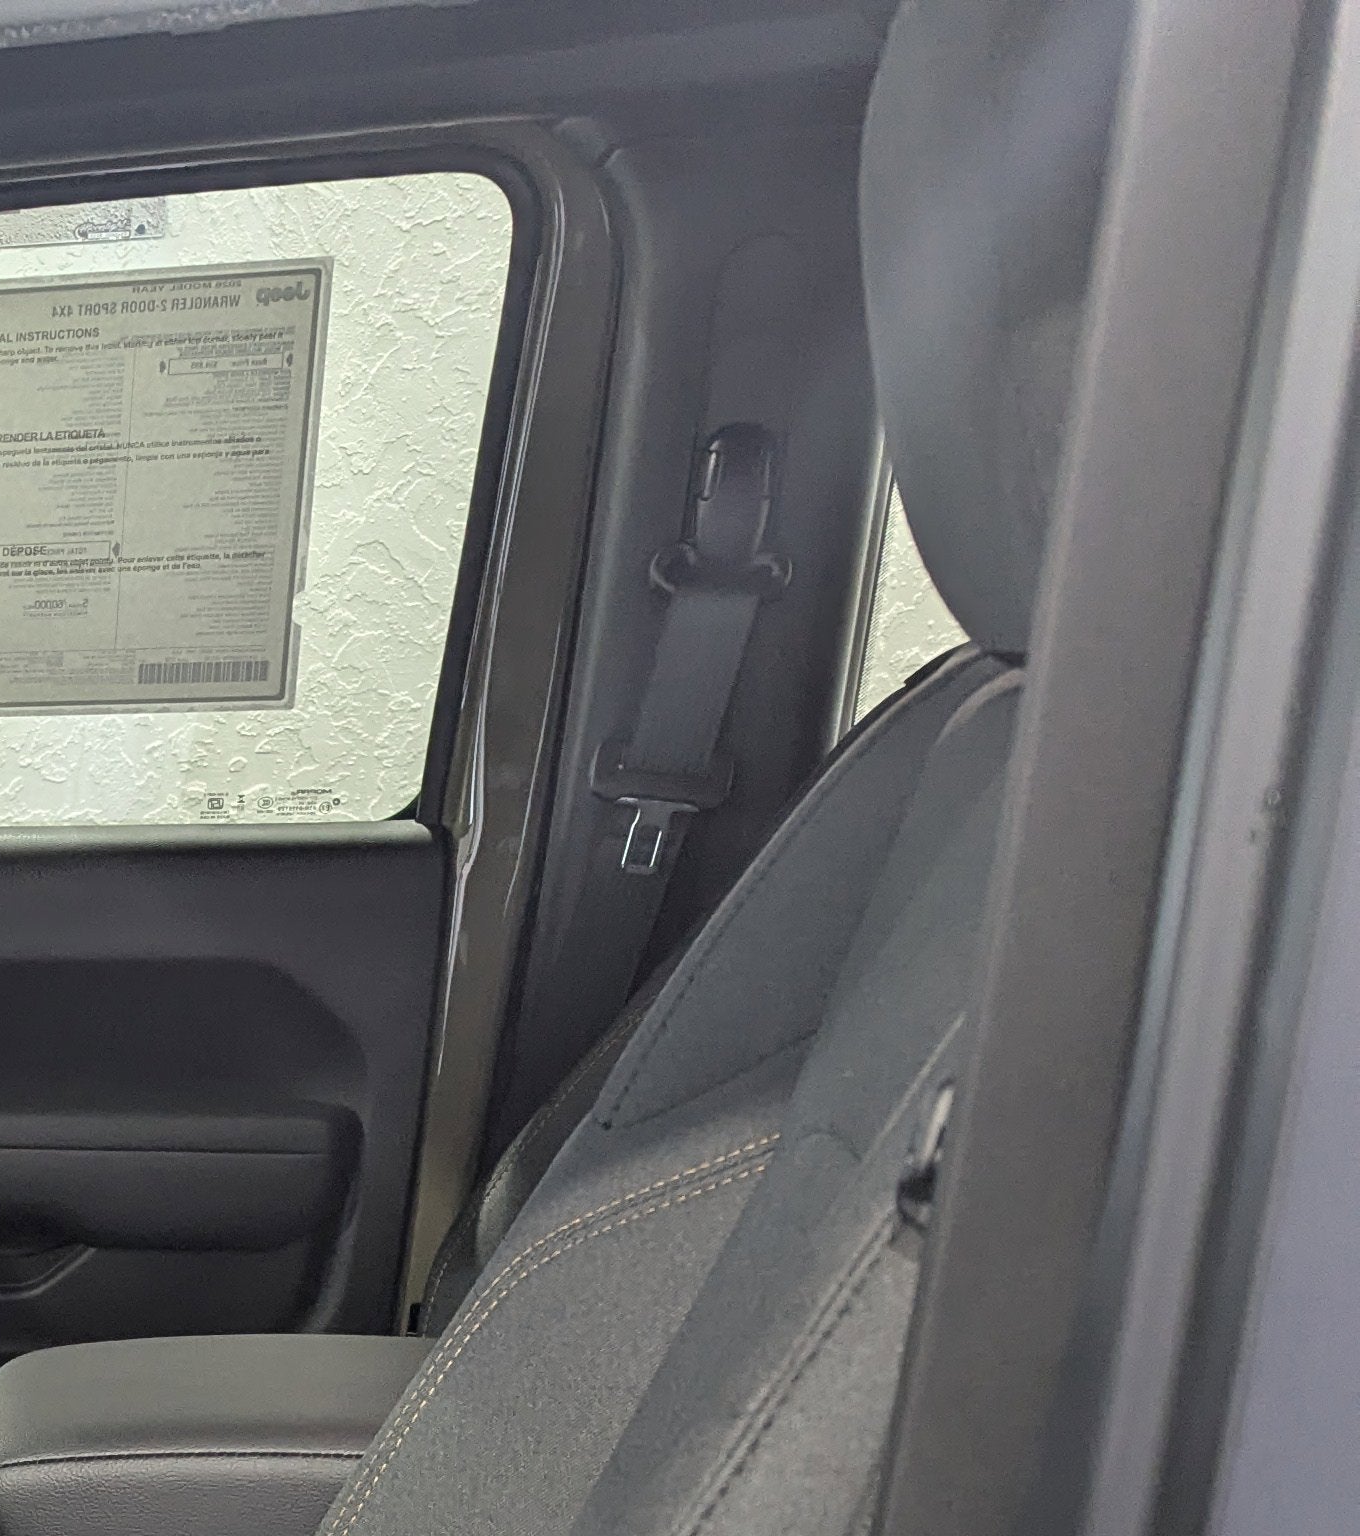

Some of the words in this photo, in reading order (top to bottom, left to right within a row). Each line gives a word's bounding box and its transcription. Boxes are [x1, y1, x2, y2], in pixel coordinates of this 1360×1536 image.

[15, 327, 100, 342] INSTRUCTIONS
[40, 431, 52, 441] LA
[54, 429, 106, 441] ETIQUETA
[2, 545, 47, 557] DÉPOSE
